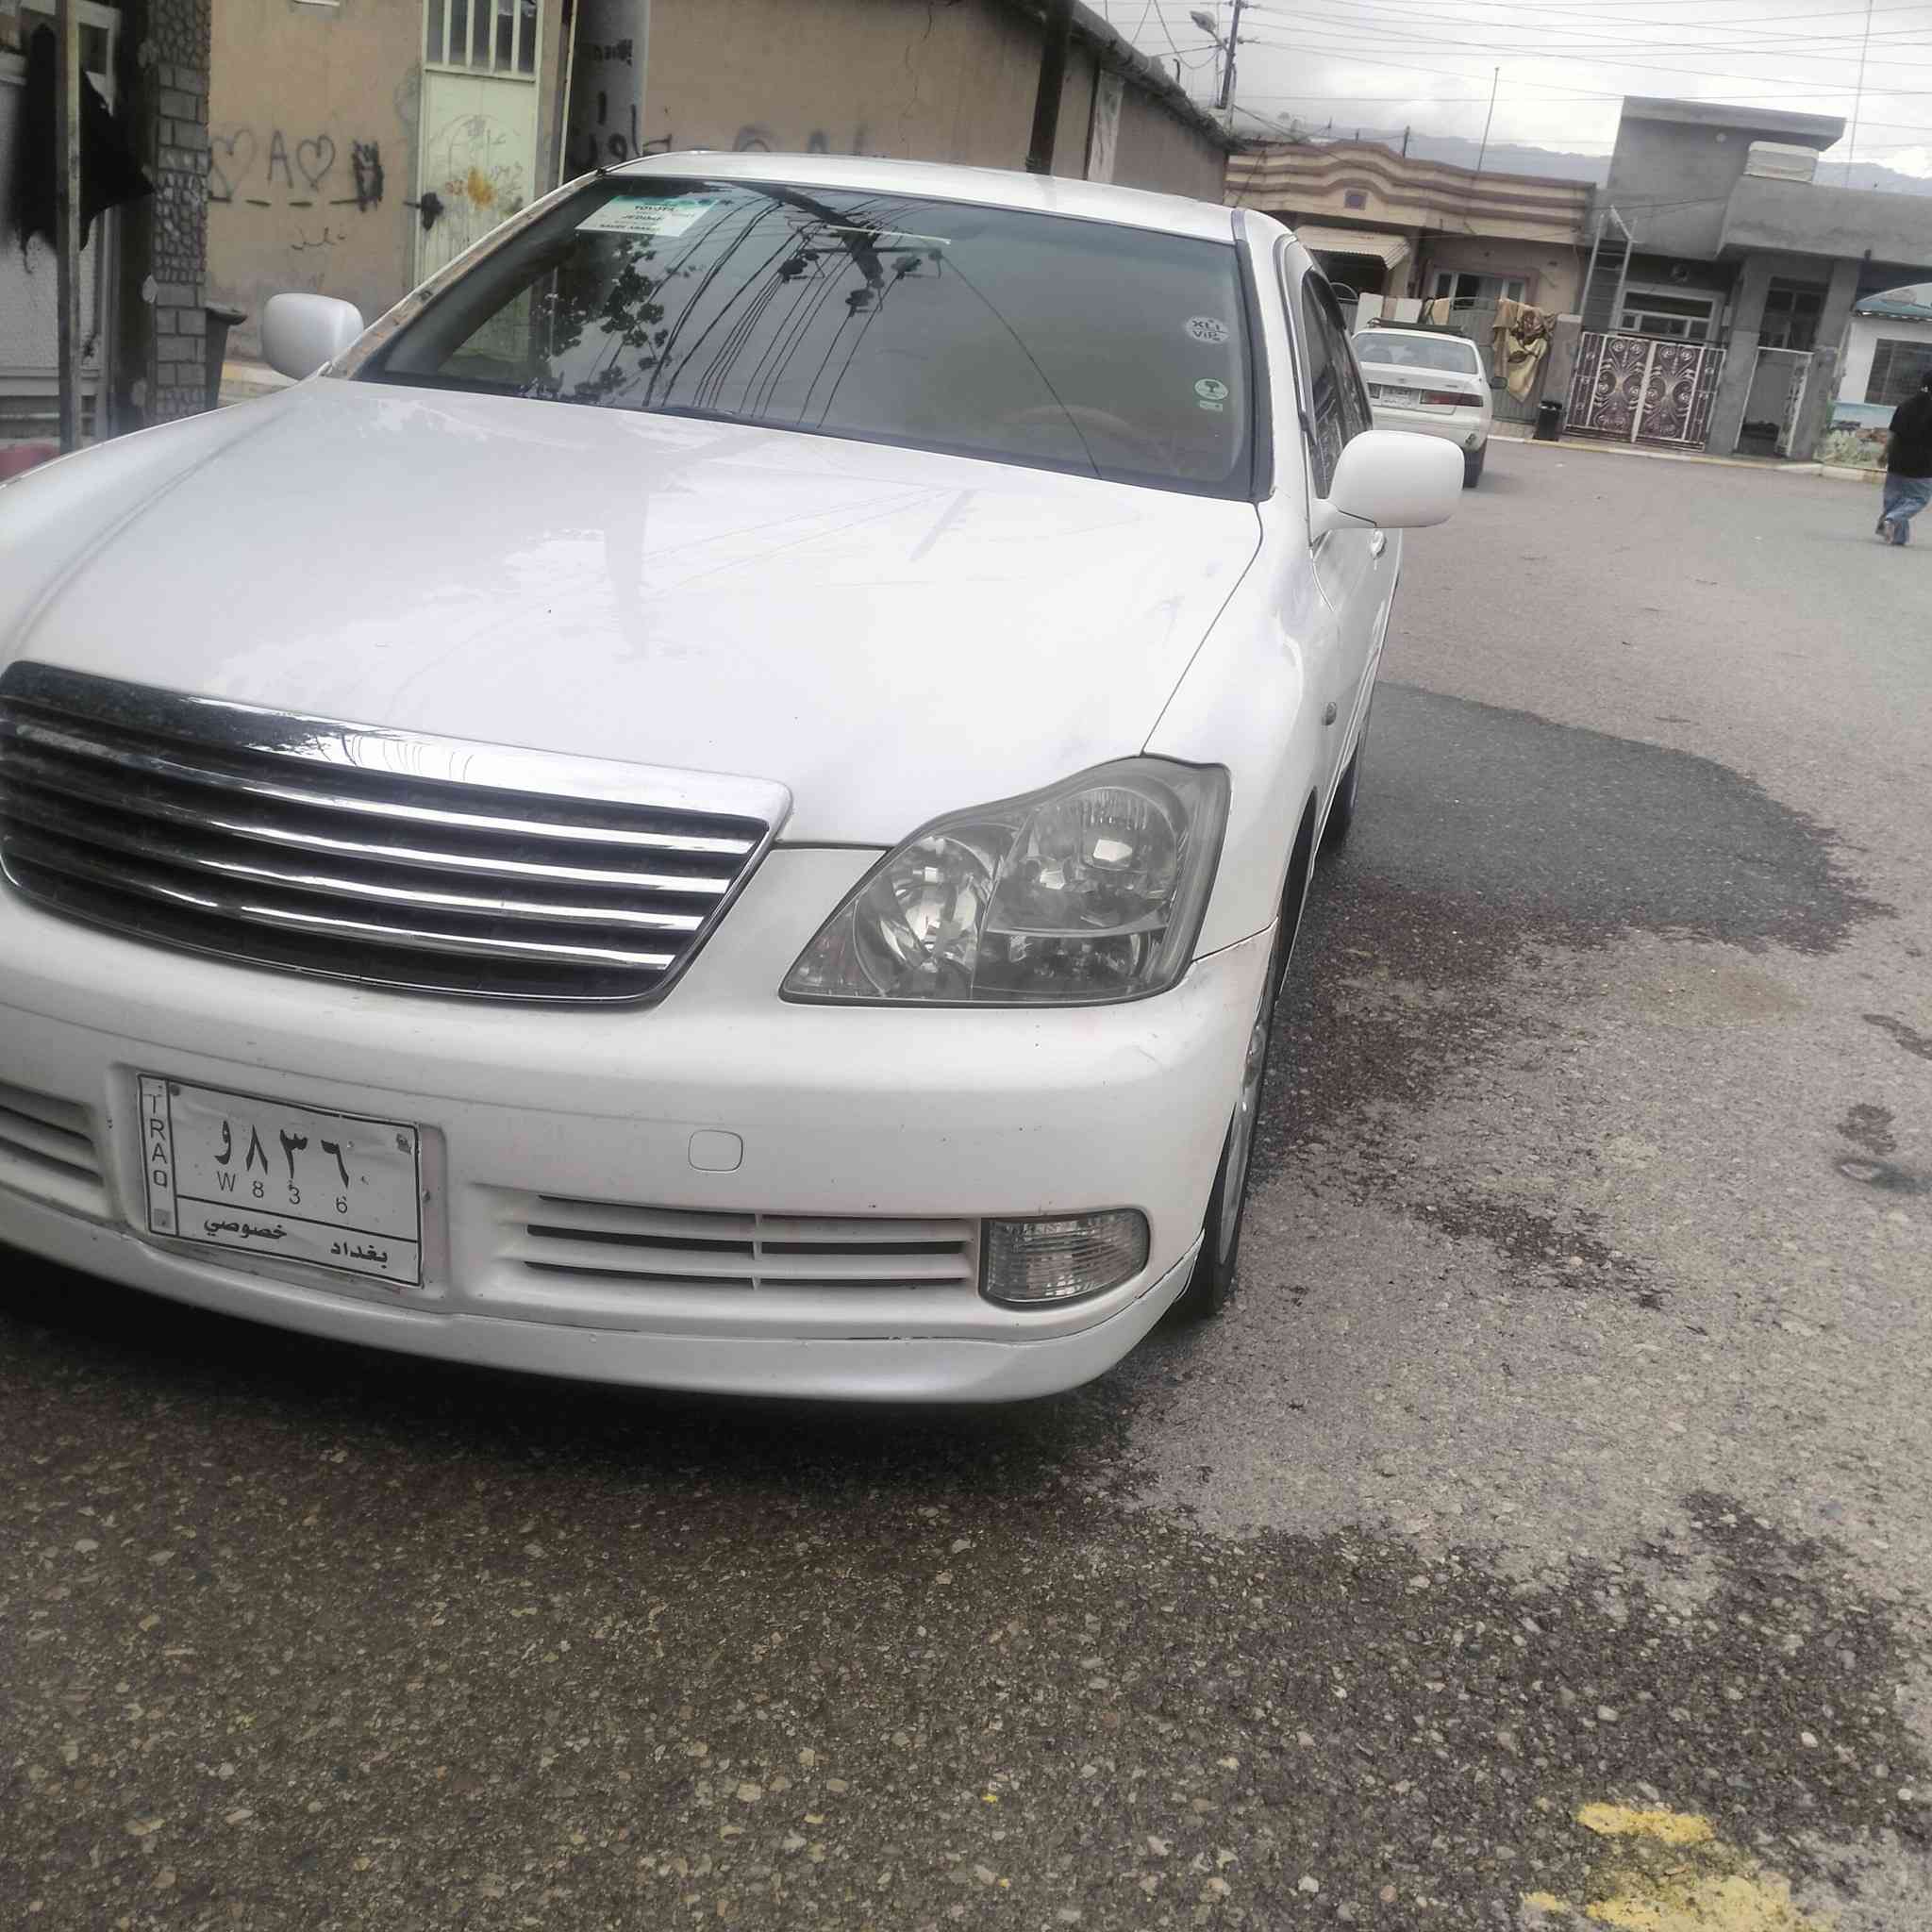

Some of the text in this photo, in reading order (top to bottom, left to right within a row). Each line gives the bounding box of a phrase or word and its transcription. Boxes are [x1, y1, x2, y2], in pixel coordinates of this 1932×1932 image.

[143, 1092, 168, 1189] IRAQ
[204, 1217, 287, 1241] خصوصي
[330, 1241, 388, 1270] بغداد
